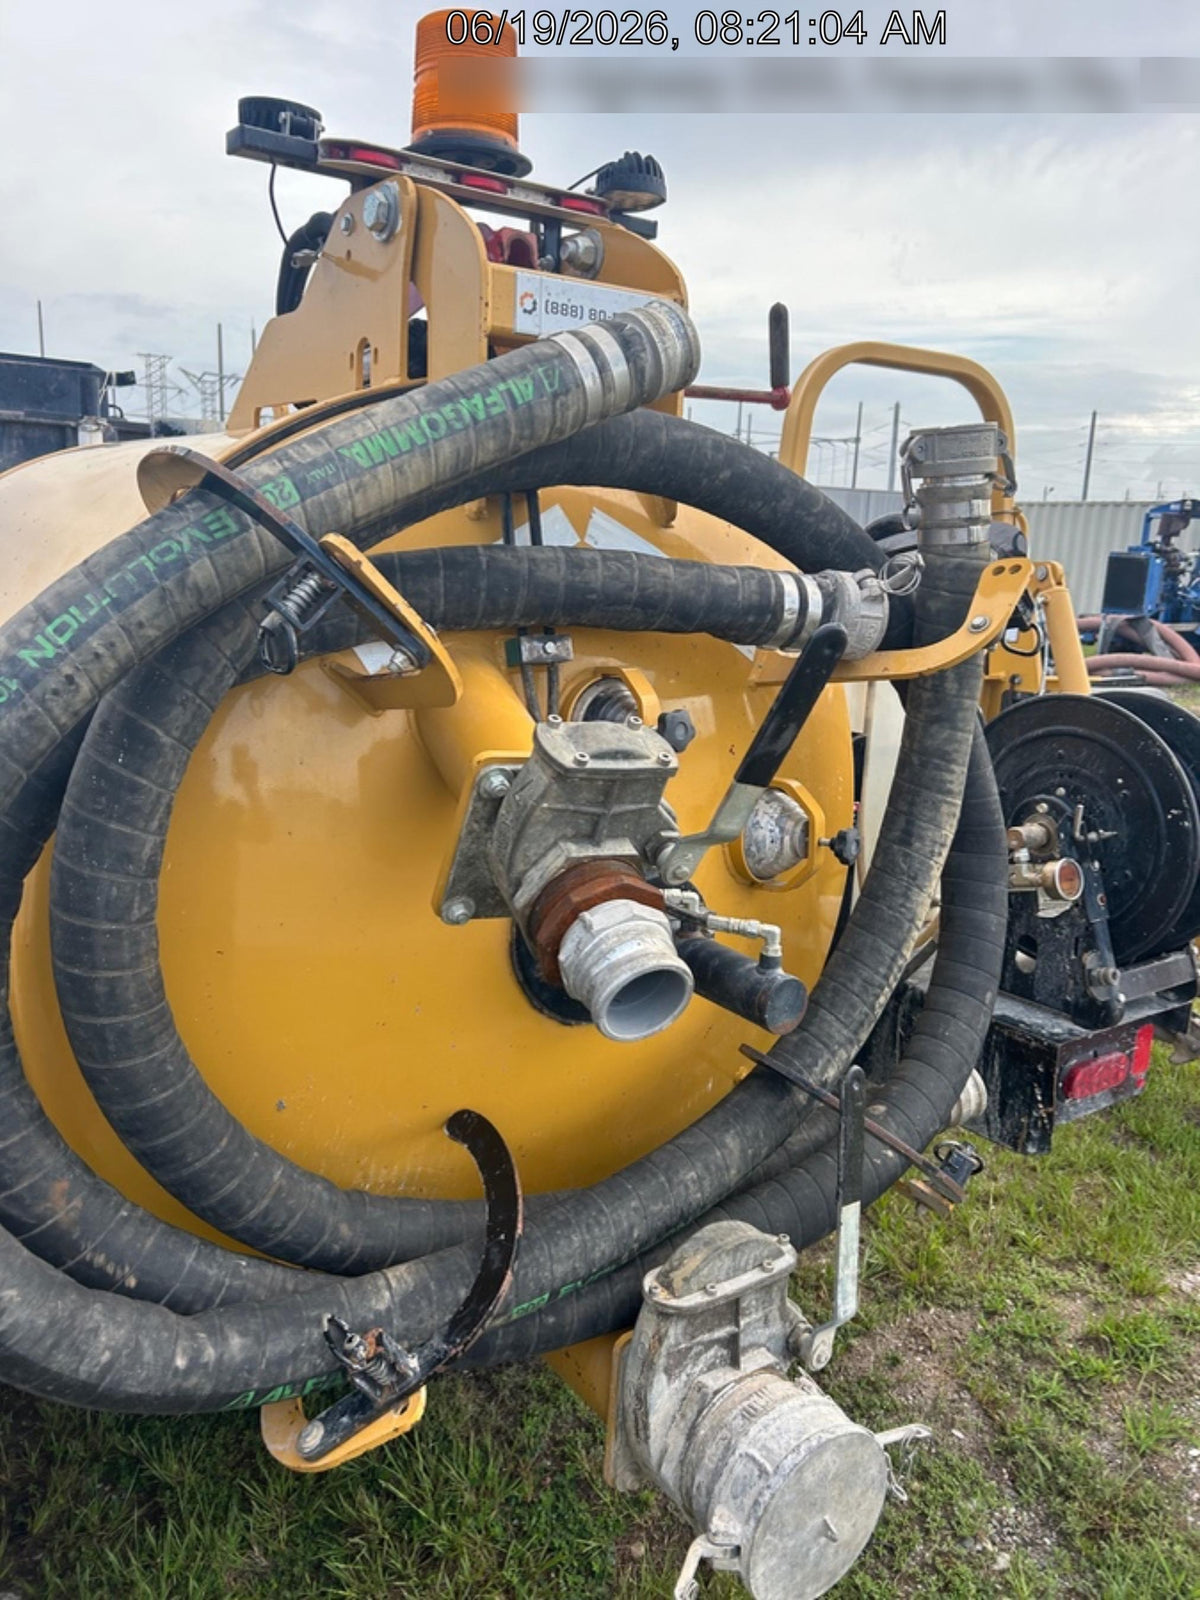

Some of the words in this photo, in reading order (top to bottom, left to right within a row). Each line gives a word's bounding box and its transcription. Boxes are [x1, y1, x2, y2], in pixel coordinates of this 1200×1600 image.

[545, 300, 584, 320] (888)
[337, 376, 534, 469] ALFAGOMMA
[306, 463, 336, 484] ITALY
[18, 506, 240, 668] EVOLUTION
